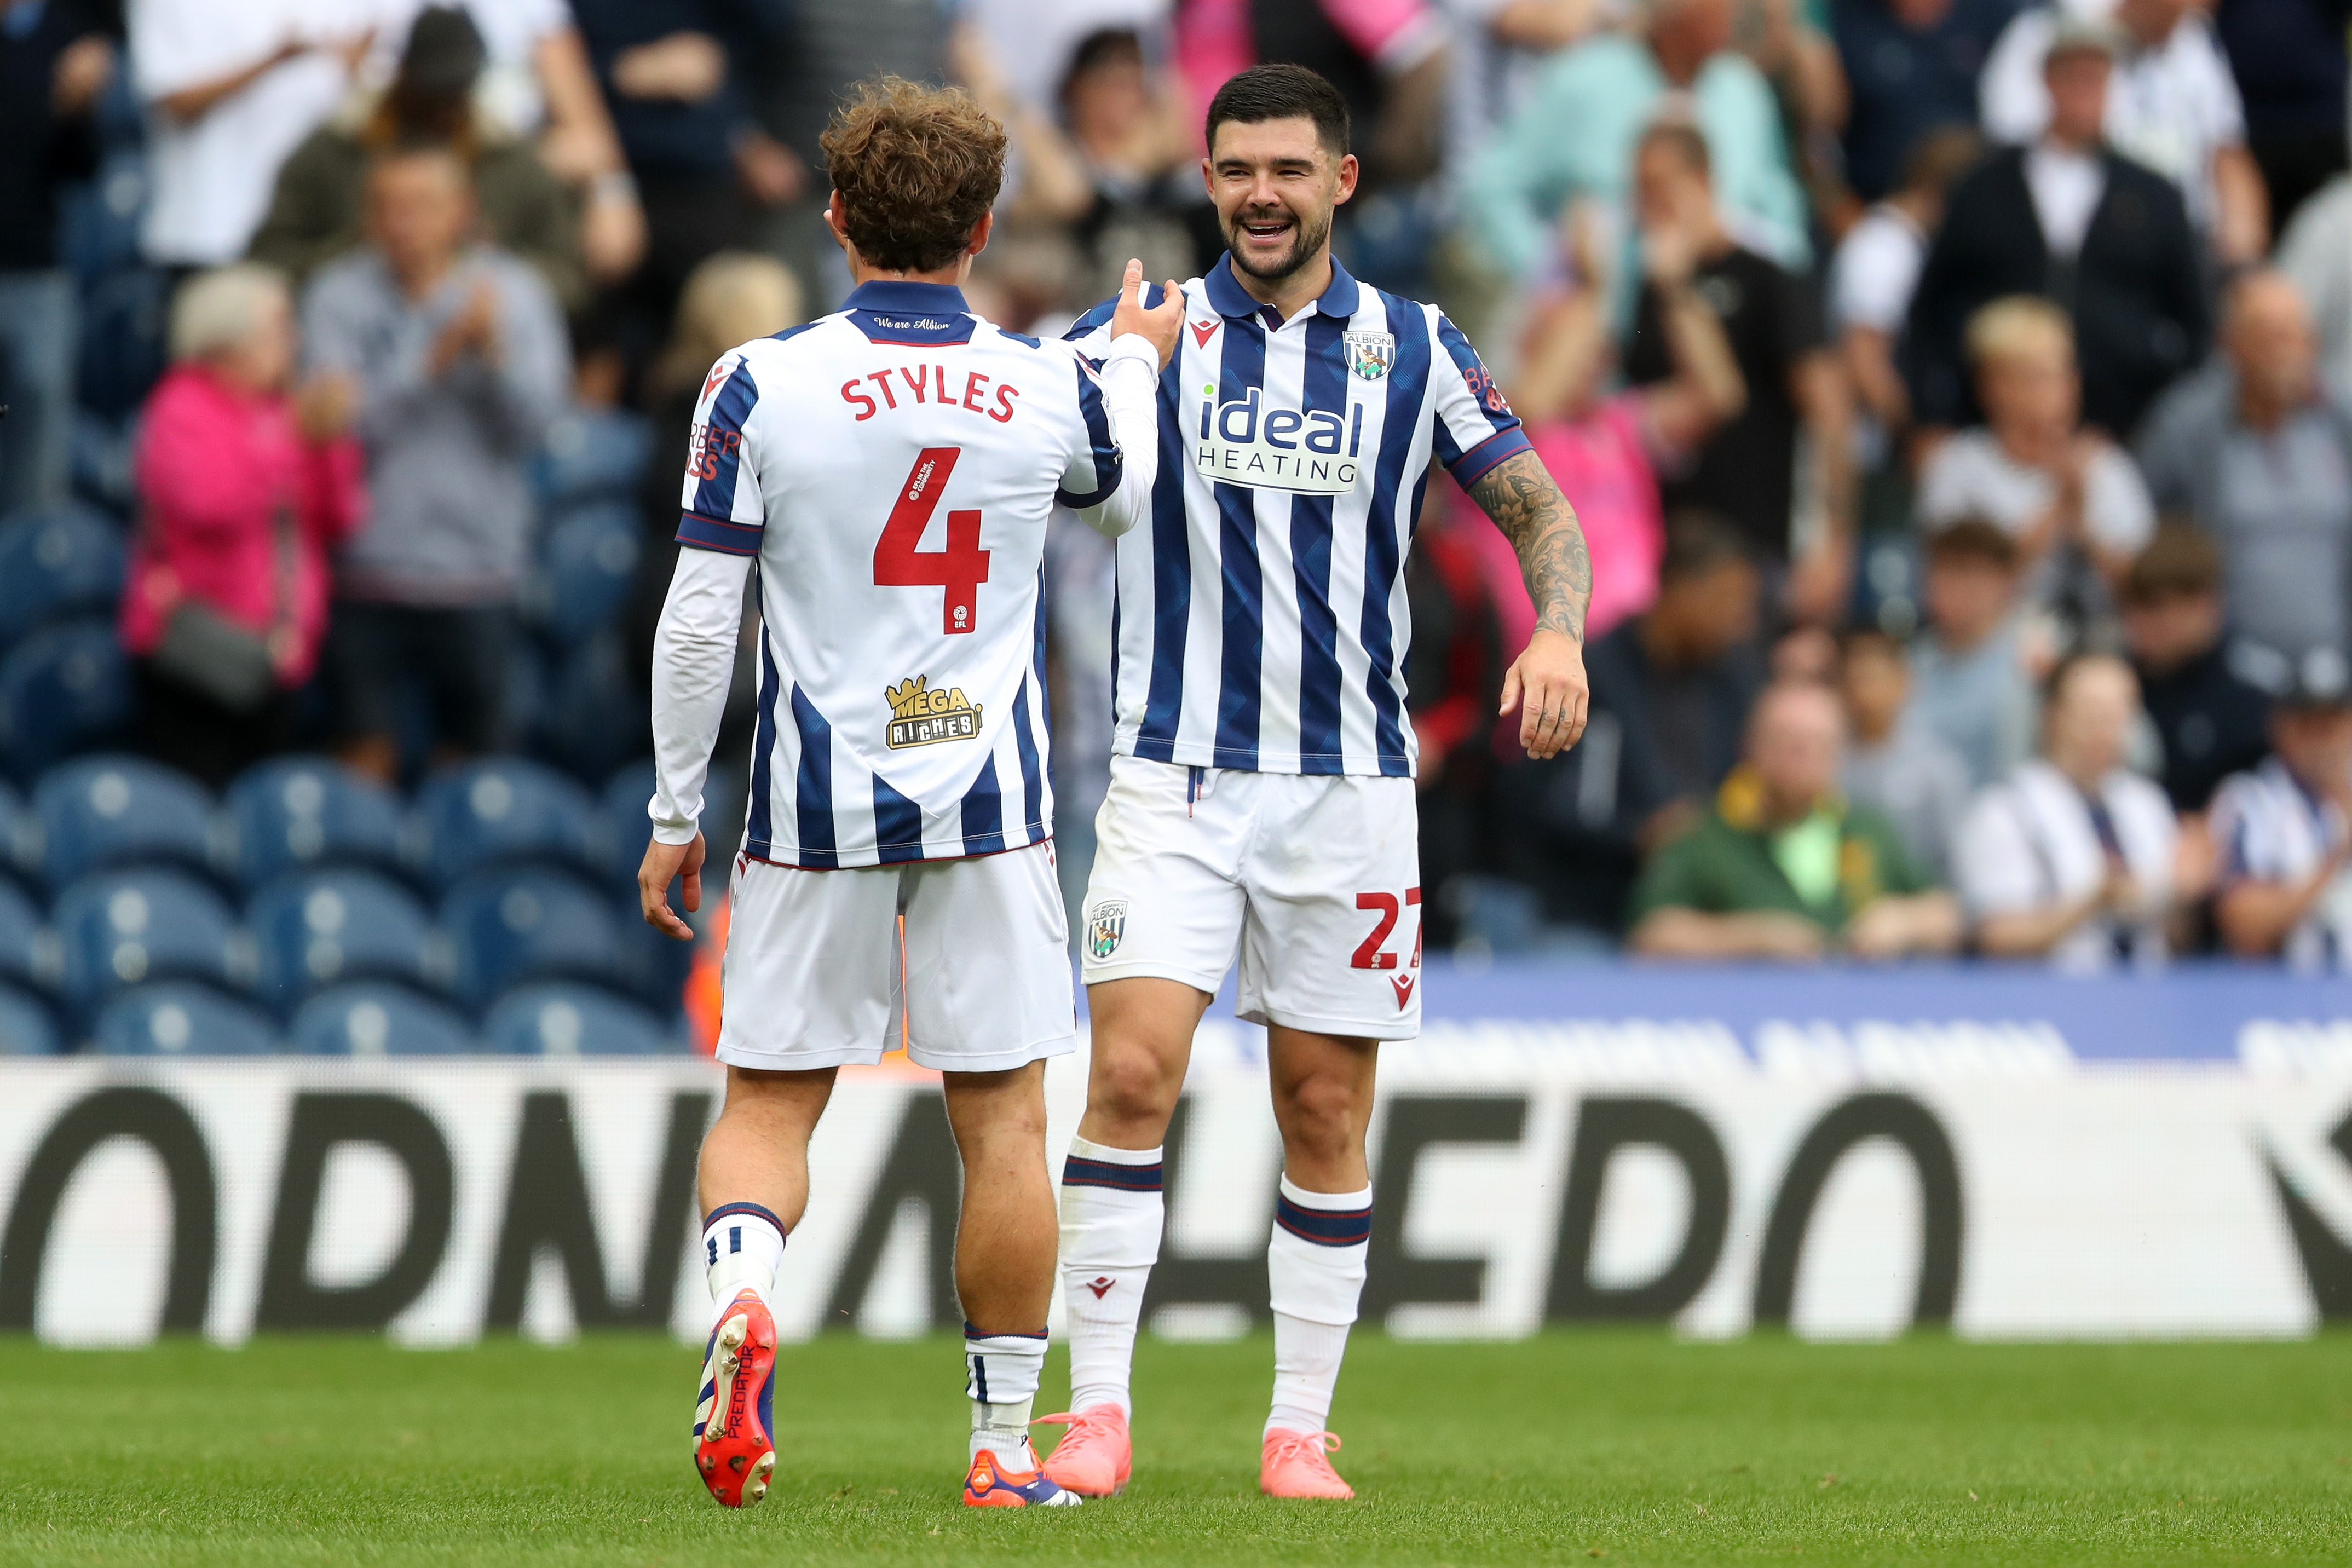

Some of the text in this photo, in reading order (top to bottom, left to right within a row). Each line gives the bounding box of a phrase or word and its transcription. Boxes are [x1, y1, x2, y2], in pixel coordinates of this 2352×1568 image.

[874, 317, 893, 328] We
[913, 318, 950, 330] Albion
[1347, 336, 1391, 346] ALBION
[840, 364, 1020, 423] STYLES
[1200, 384, 1363, 458] ideal
[912, 480, 921, 490] EFL
[920, 463, 929, 473] THE
[917, 459, 936, 492] COMMUNITY
[1198, 446, 1357, 483] HEATING
[873, 447, 990, 635] 4
[895, 688, 970, 718] MEGA
[893, 716, 972, 742] RICHES
[1091, 907, 1123, 922] ALBION
[728, 1345, 756, 1438] PREDATOR
